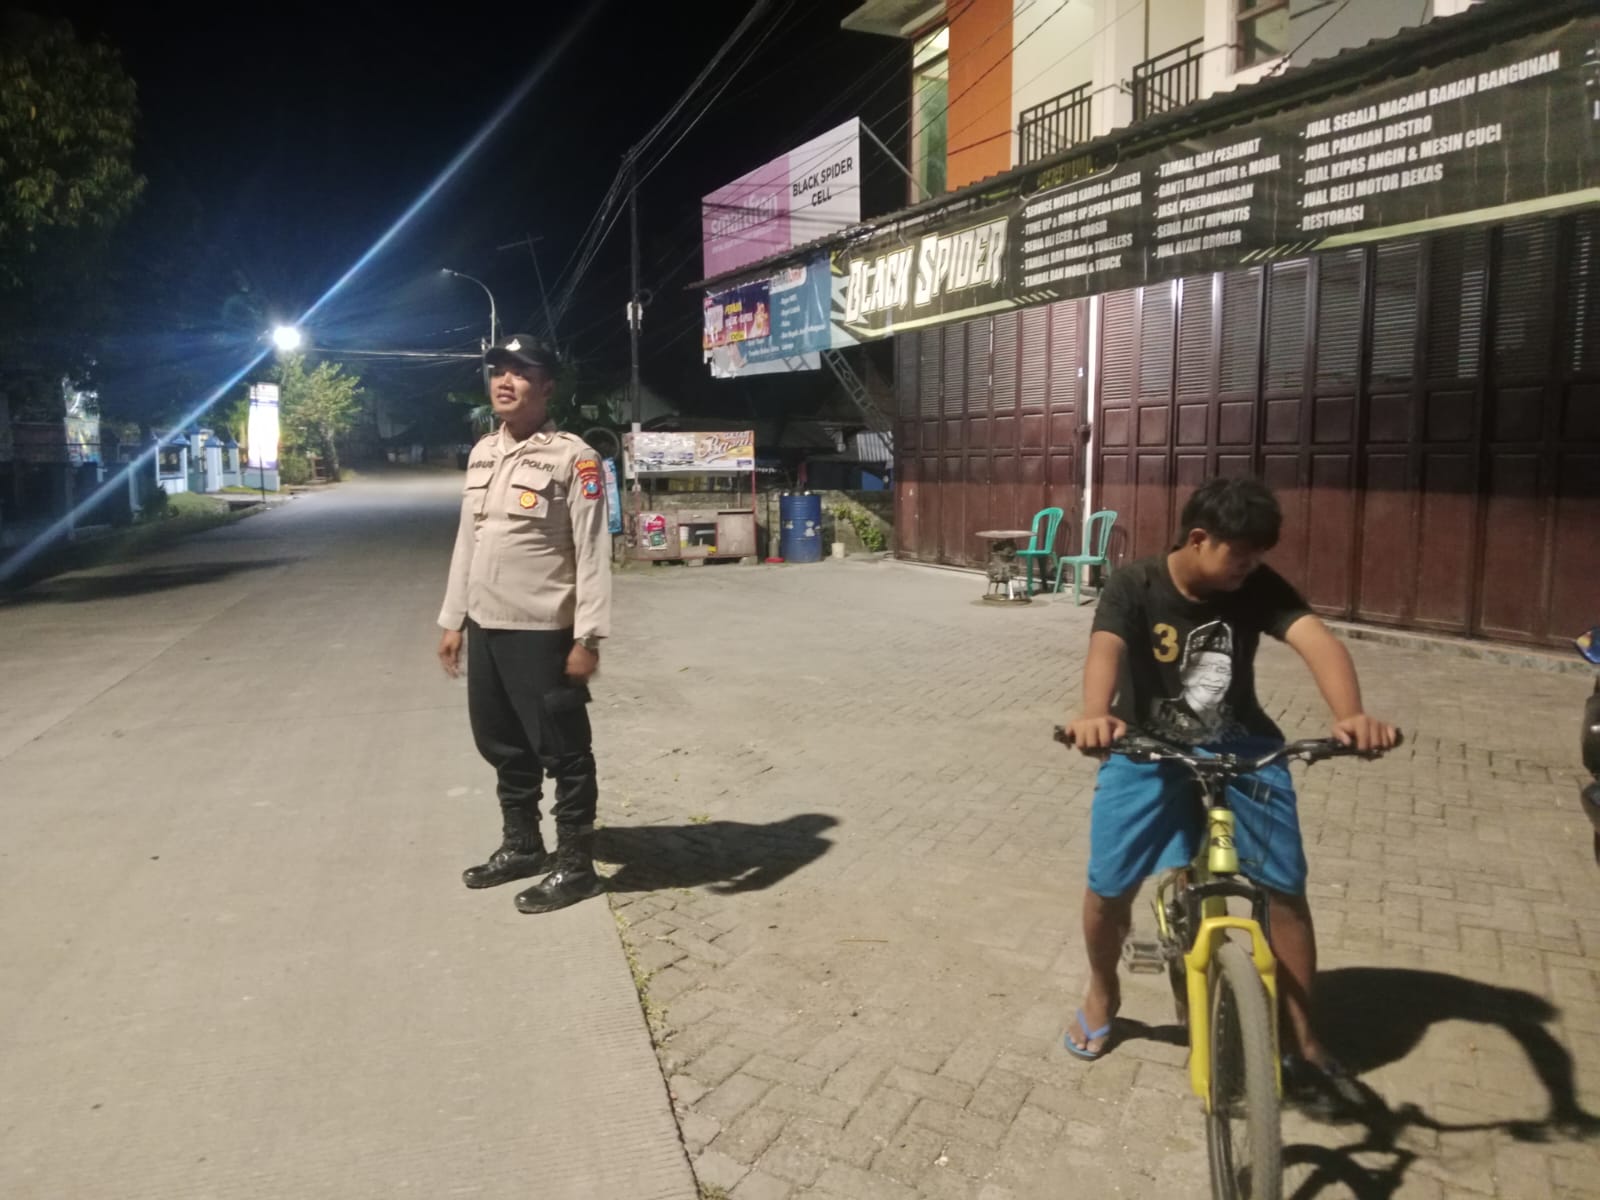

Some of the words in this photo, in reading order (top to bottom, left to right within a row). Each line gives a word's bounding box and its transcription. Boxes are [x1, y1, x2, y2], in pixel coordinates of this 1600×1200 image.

[1305, 118, 1331, 139] JUAL
[1333, 105, 1376, 132] SEGALA
[1379, 91, 1426, 120] MACAM
[1428, 76, 1476, 106] BAHAN
[1478, 50, 1560, 92] BANGUNAN
[1160, 157, 1194, 177] TAMBAL
[1195, 151, 1214, 168] BAN
[1215, 137, 1261, 163] PESAWAT
[1304, 165, 1329, 185] JUAL
[1331, 157, 1366, 179] KIPAS
[1367, 146, 1406, 170] ANGIN
[1408, 146, 1418, 162] &
[1420, 132, 1463, 158] MESIN
[1465, 123, 1502, 148] CUCI
[1305, 142, 1330, 162] JUAL
[1332, 128, 1383, 155] PAKAIAN
[1384, 115, 1432, 142] DISTRO
[792, 176, 819, 198] BLACK
[821, 157, 853, 184] SPIDER
[1159, 180, 1184, 198] GANTI
[1186, 174, 1205, 191] BAN
[1206, 166, 1238, 187] MOTOR
[1240, 166, 1247, 178] &
[1249, 154, 1281, 176] MOBIL
[1303, 189, 1328, 208] JUAL
[1330, 182, 1354, 202] BELI
[1356, 173, 1399, 197] MOTOR
[1401, 164, 1443, 188] BEKAS
[812, 190, 832, 207] CELL
[1026, 199, 1052, 218] SERVICE
[1054, 192, 1078, 209] MOTOR
[1104, 183, 1110, 194] &
[1042, 217, 1052, 230] UP
[1078, 207, 1087, 220] UP
[1113, 192, 1142, 211] MOTOR
[1158, 201, 1178, 219] JASA
[1180, 183, 1254, 213] PENERAWANGAN
[1157, 221, 1181, 238] SEDIA
[1182, 216, 1205, 233] ALAT
[1205, 206, 1250, 228] HIPNOTIS
[1302, 204, 1364, 231] RESTORASI
[1024, 237, 1044, 253] SEDIA
[1025, 253, 1050, 270] TAMBAL
[1051, 250, 1064, 264] BAN
[1088, 244, 1094, 255] &
[1095, 233, 1132, 253] TUBELESS
[1157, 242, 1175, 259] JUAL
[1176, 237, 1201, 254] AYAM
[845, 246, 914, 326] BLACK
[914, 216, 1009, 307] SPIDER
[1024, 271, 1049, 287] TAMBAL
[1050, 268, 1064, 281] BAN
[521, 459, 556, 472] POLRI
[1153, 623, 1179, 662] 3
